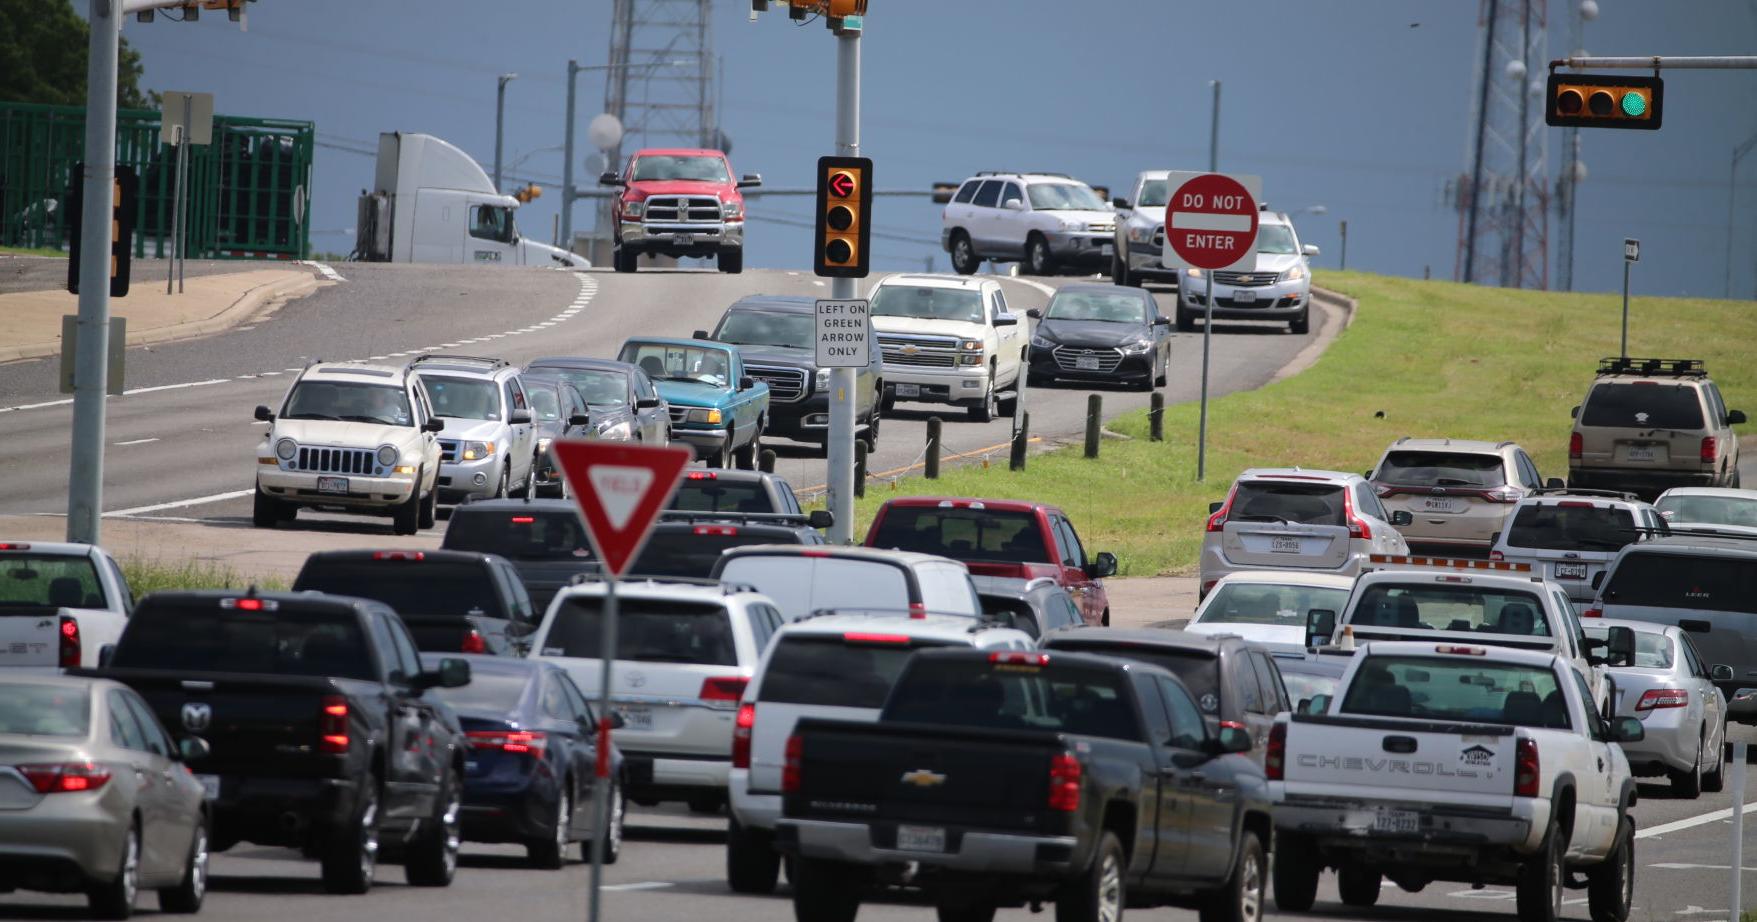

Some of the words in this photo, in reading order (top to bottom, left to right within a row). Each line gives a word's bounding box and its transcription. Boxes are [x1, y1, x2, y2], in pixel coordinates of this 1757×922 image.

[1183, 194, 1204, 208] DO
[1213, 195, 1244, 210] NOT
[1186, 234, 1234, 249] ENTER
[819, 305, 844, 314] LEFT
[849, 305, 865, 314] ON
[824, 319, 862, 328] GREEN
[821, 333, 864, 342] ARROW
[828, 347, 857, 356] ONLY
